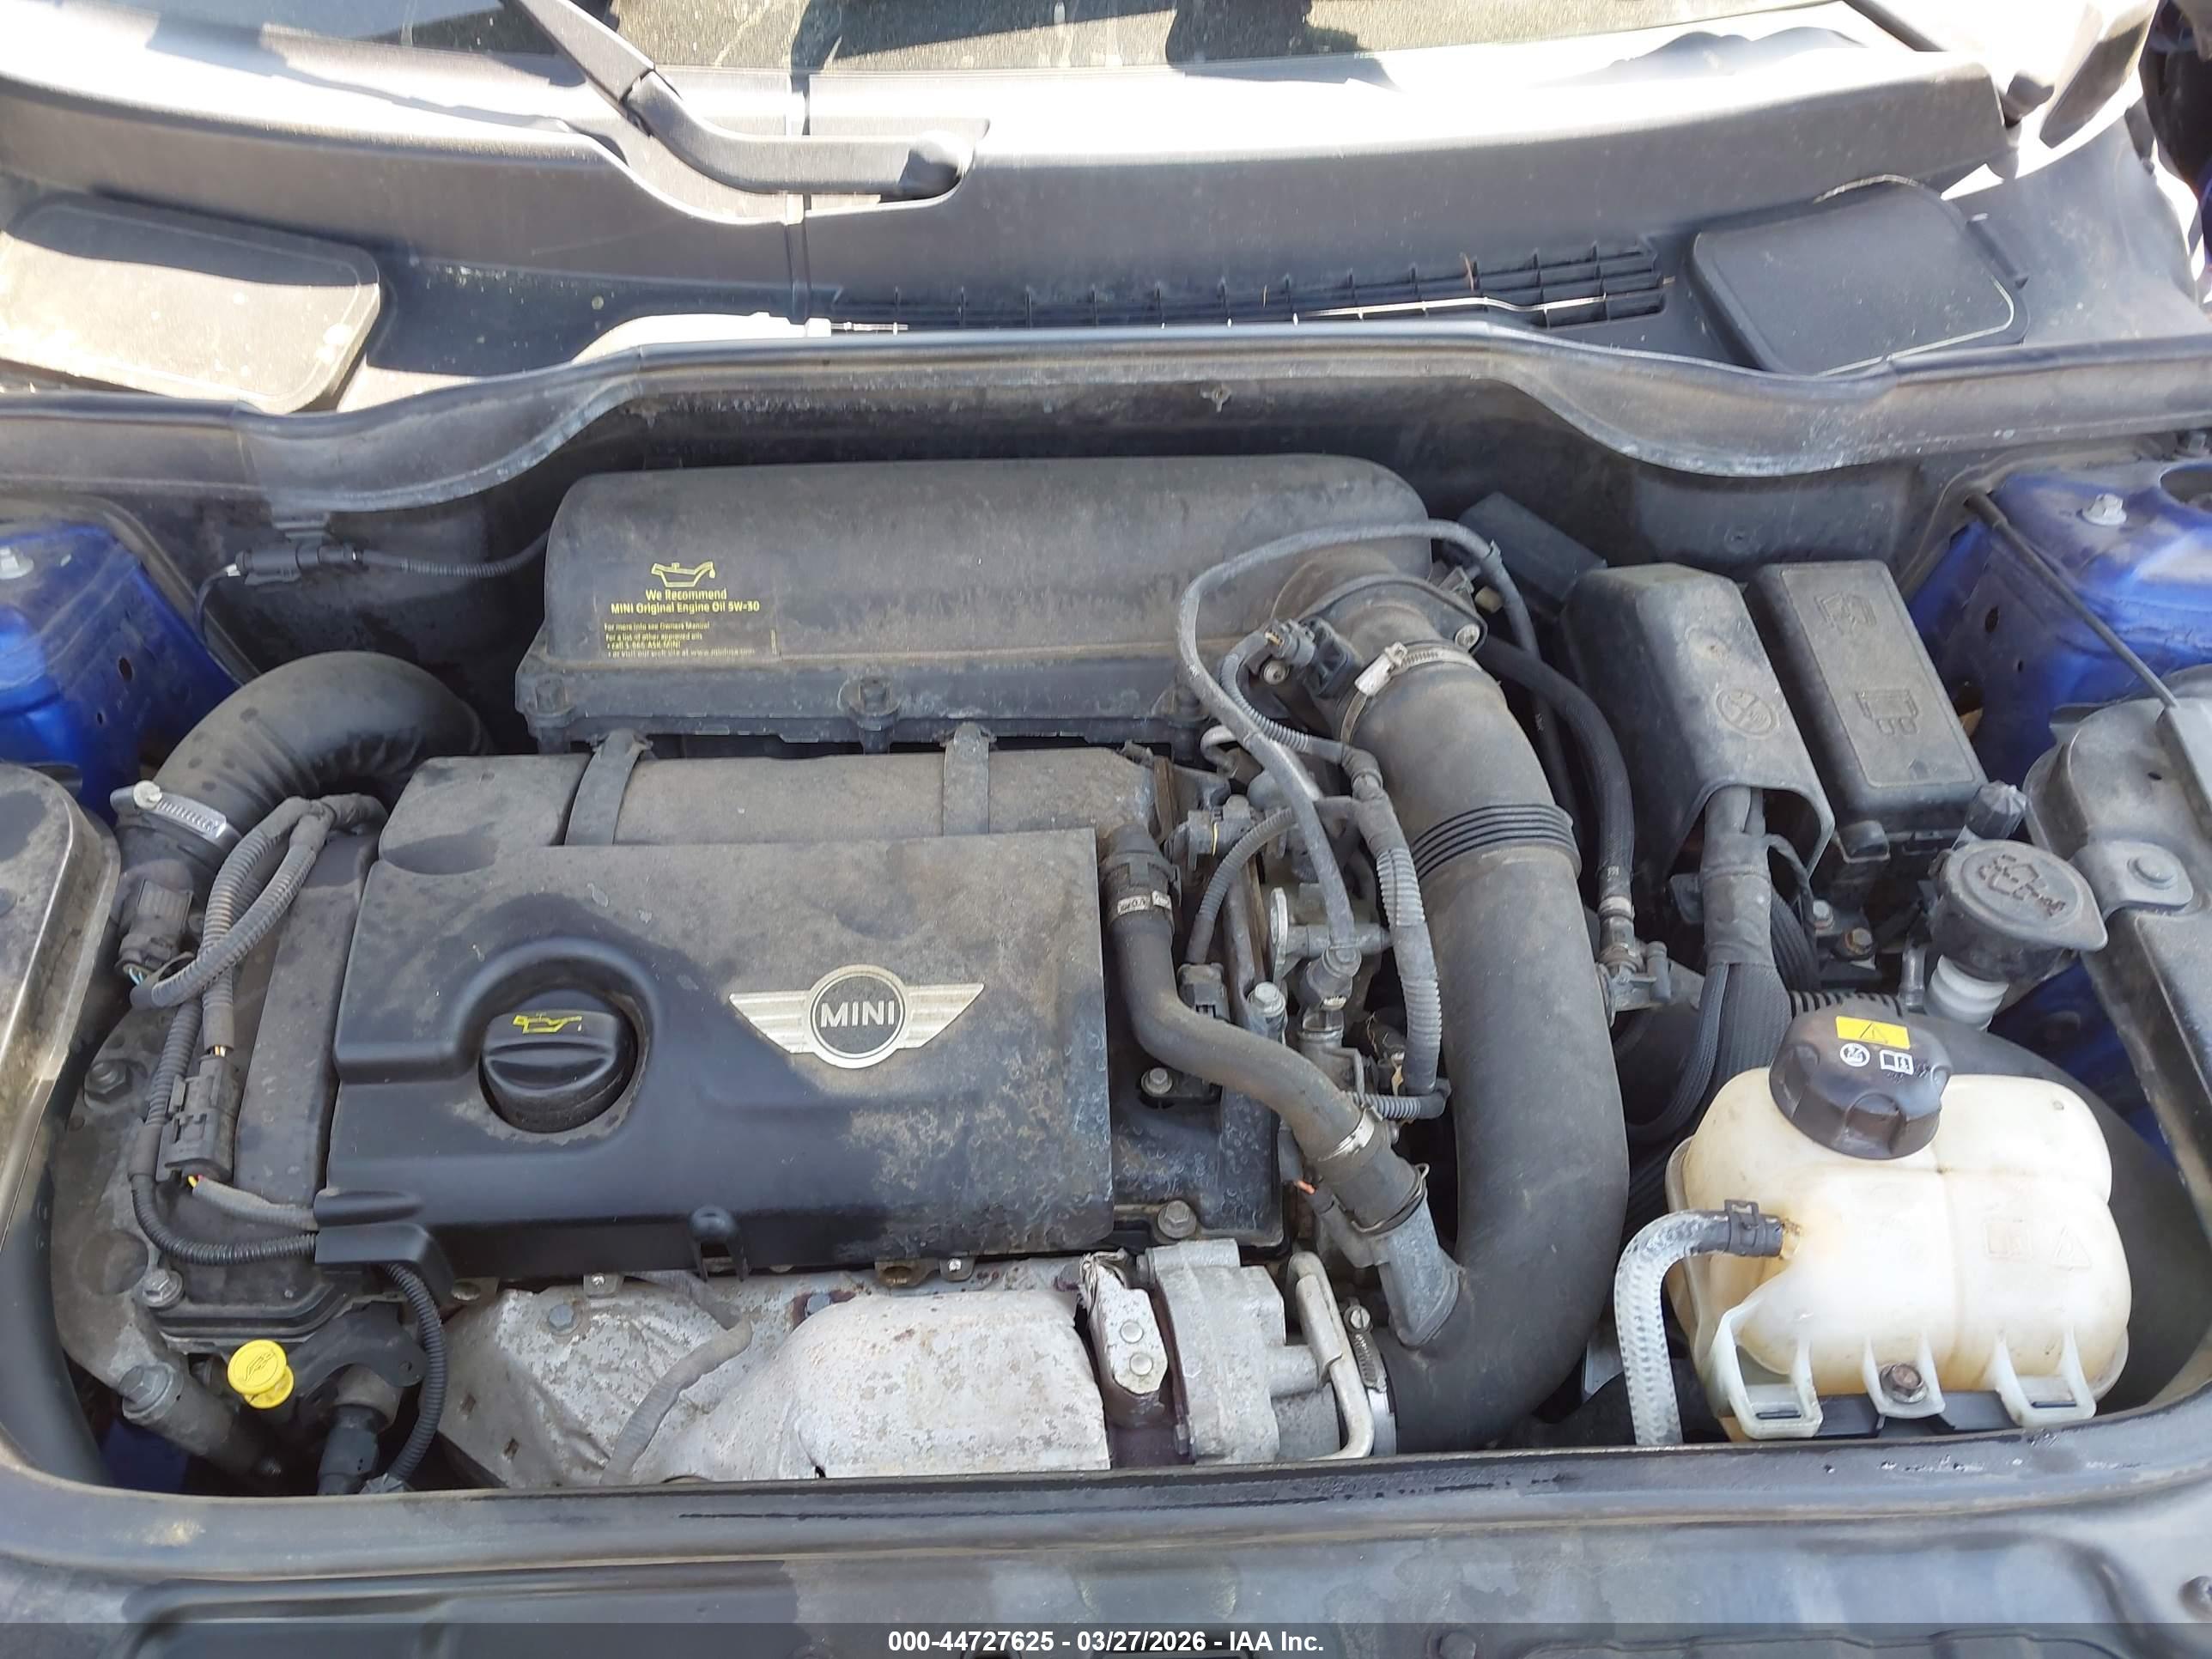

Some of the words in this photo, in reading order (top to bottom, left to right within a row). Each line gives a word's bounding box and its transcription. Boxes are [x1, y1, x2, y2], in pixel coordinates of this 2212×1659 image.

[646, 589, 661, 600] We
[665, 588, 727, 600] Recommend
[611, 603, 634, 614] MINI
[636, 602, 675, 615] Original
[678, 602, 709, 614] Engine
[712, 601, 726, 612] Oil
[728, 601, 761, 612] 5W-30
[686, 621, 709, 629] Manual
[820, 1000, 895, 1028] MINI
